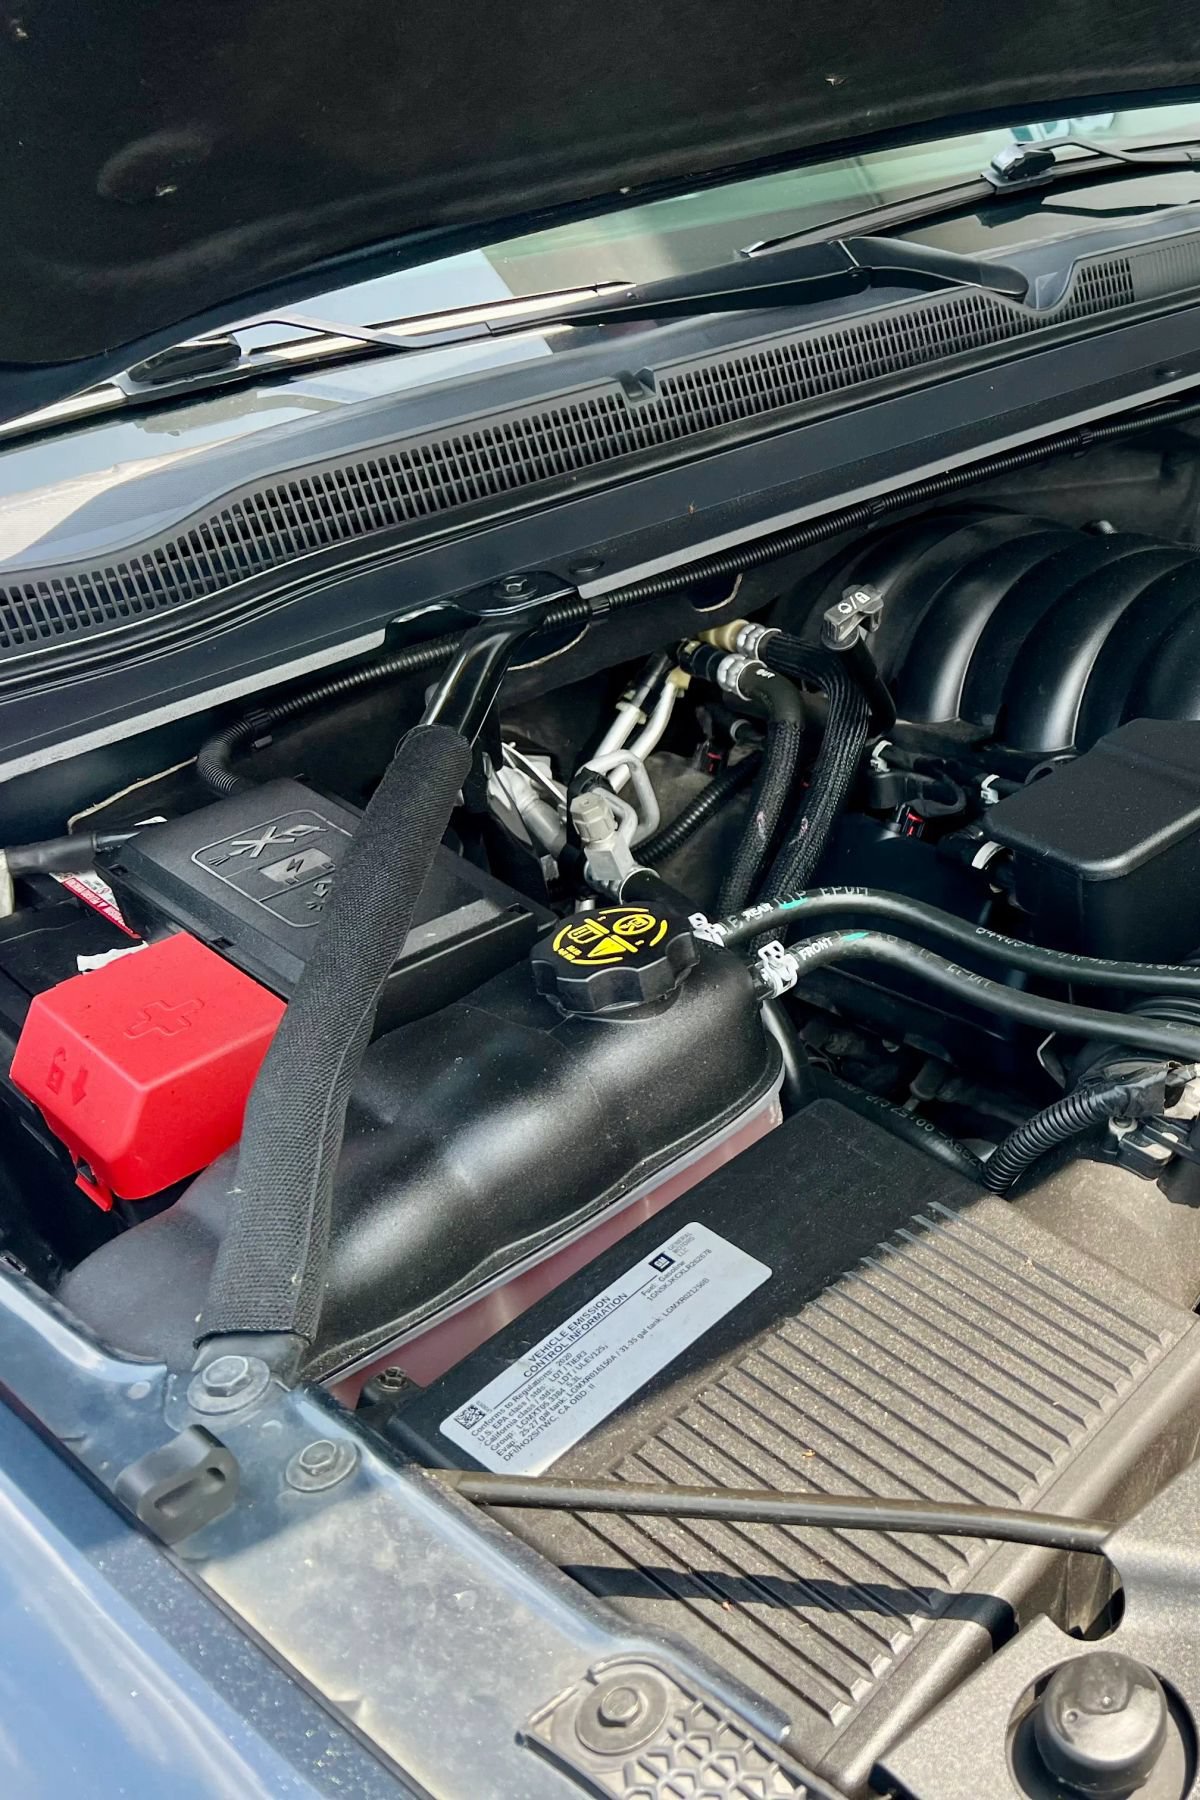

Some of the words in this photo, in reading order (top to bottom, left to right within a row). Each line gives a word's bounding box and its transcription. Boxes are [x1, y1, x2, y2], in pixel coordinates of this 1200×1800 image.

[799, 936, 833, 961] FRONT
[657, 1259, 685, 1282] Gasoline
[522, 1340, 569, 1378] CONTROL
[566, 1292, 628, 1341] INFORMATION
[527, 1329, 569, 1363] VEHICLE
[567, 1295, 611, 1331] EMISSION
[635, 1327, 650, 1339] gal
[469, 1407, 506, 1436] Conforms
[503, 1401, 513, 1409] to
[554, 1351, 573, 1366] 2020
[482, 1417, 518, 1446] California
[515, 1402, 536, 1419] class
[557, 1372, 573, 1385] LDT
[491, 1415, 509, 1429] EPA
[506, 1399, 527, 1416] class
[548, 1369, 564, 1382] LDT
[565, 1350, 587, 1367] TIER3
[556, 1403, 571, 1415] CA
